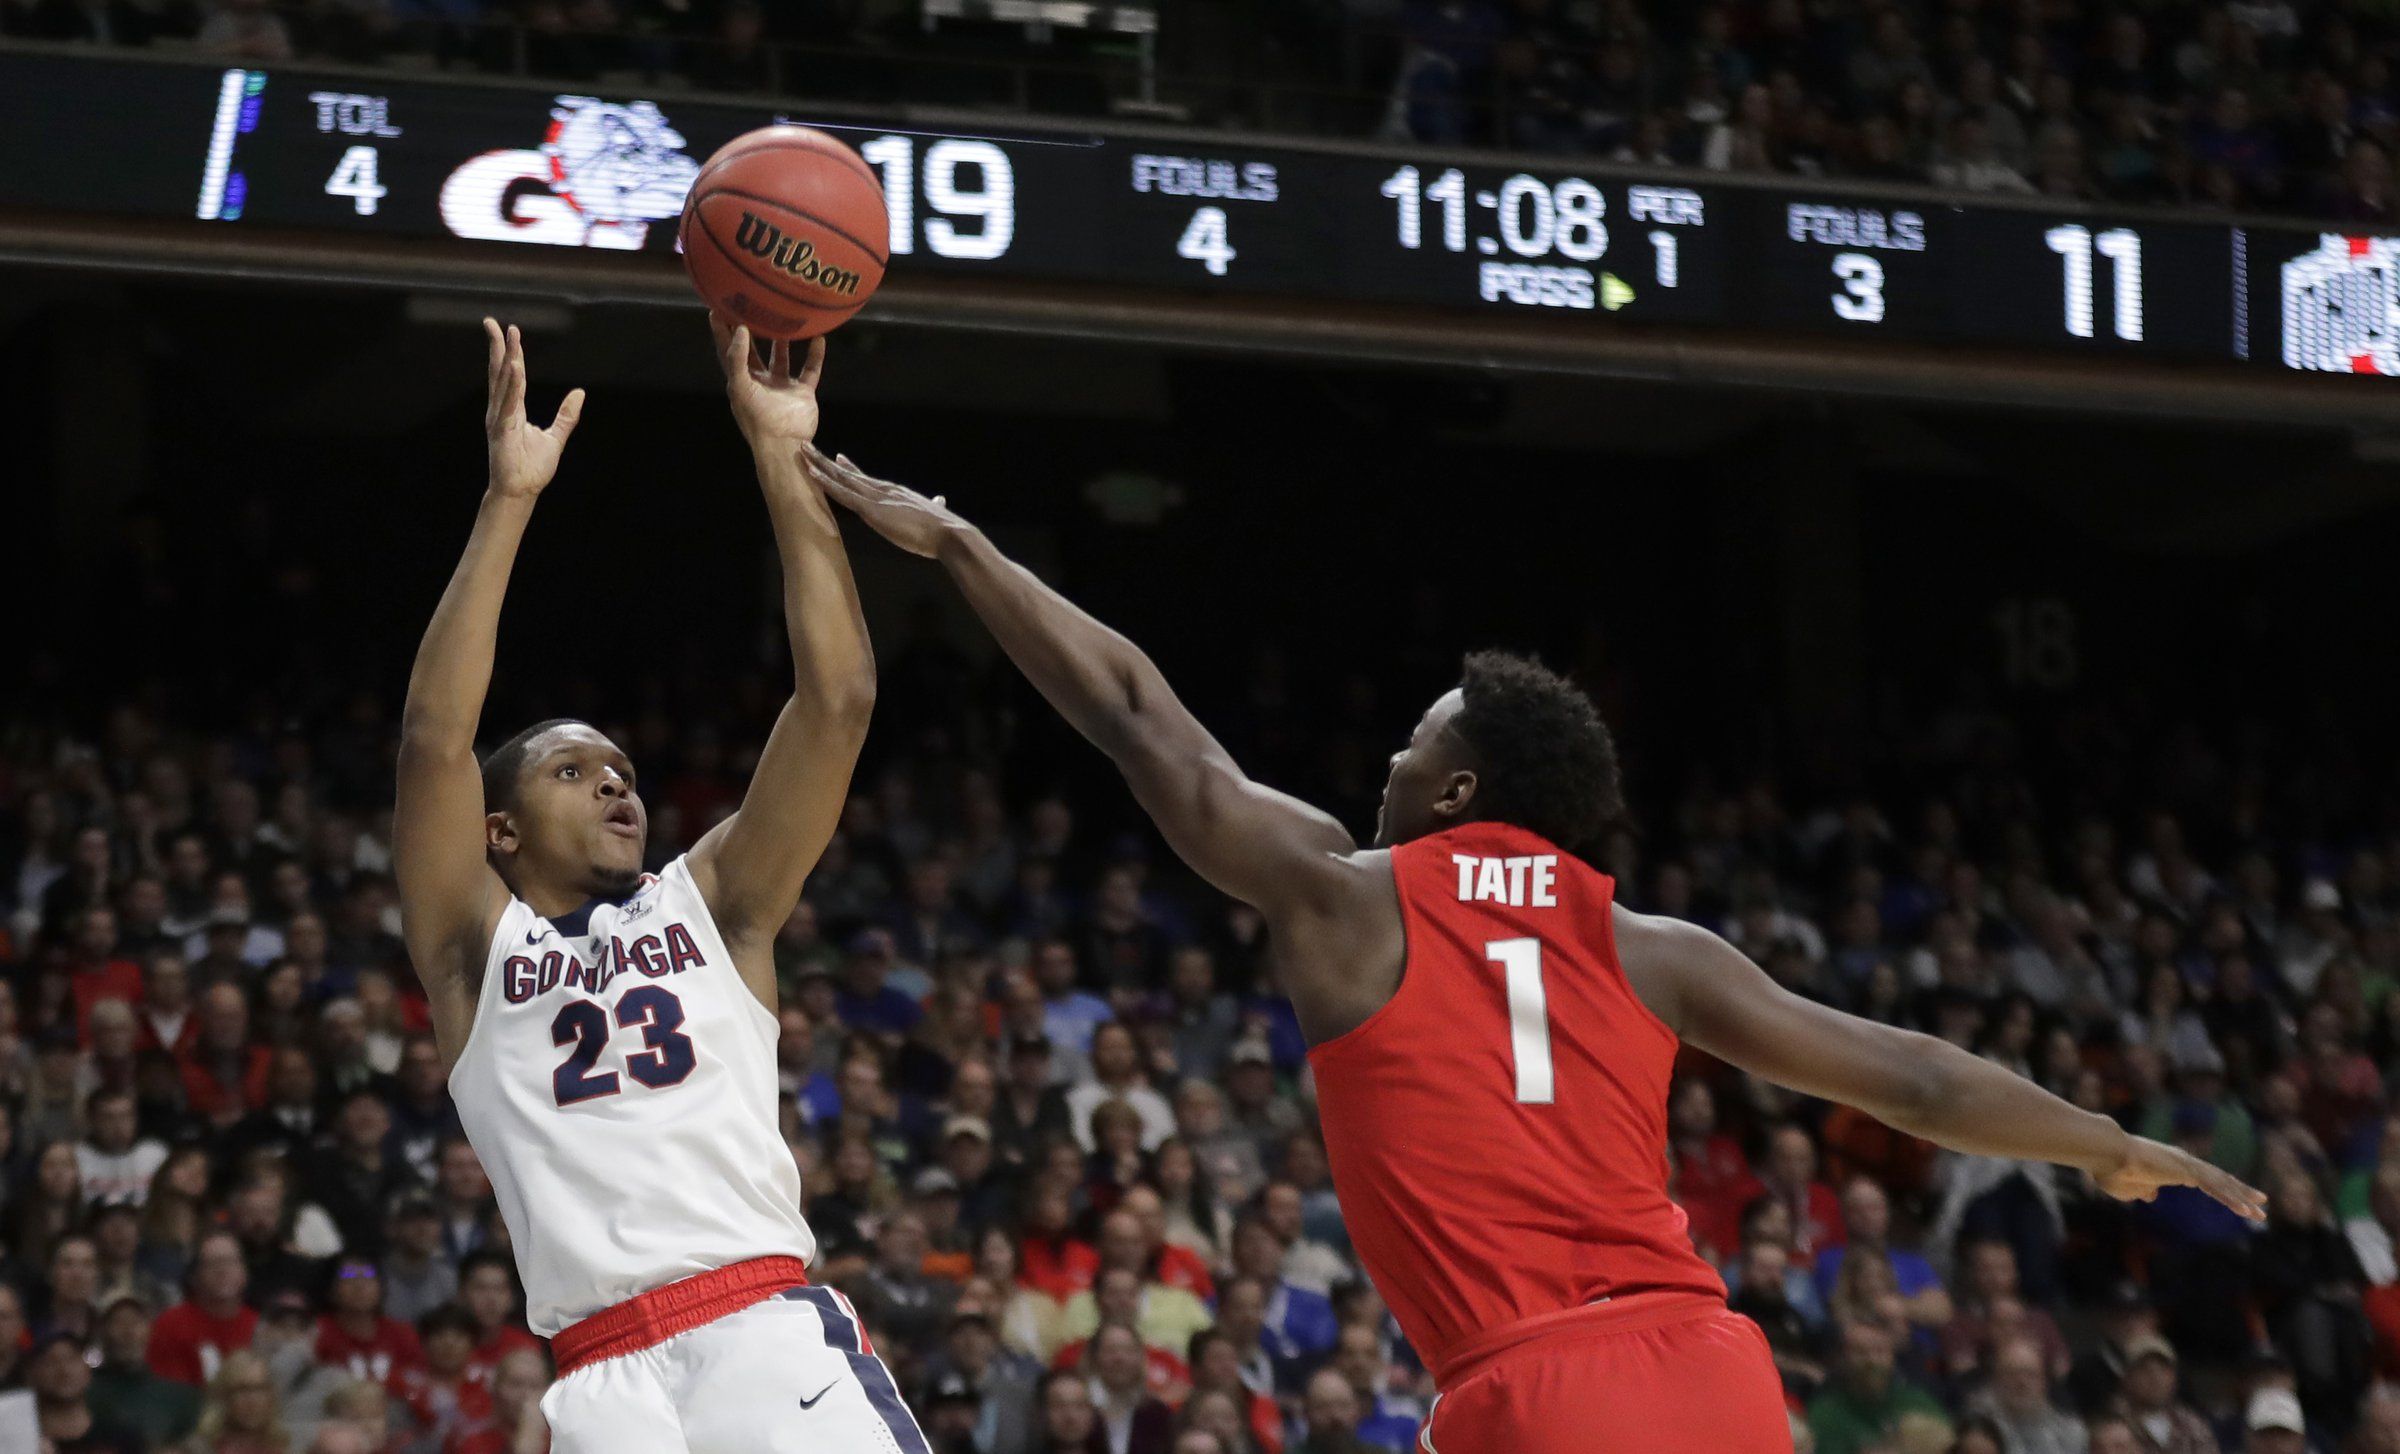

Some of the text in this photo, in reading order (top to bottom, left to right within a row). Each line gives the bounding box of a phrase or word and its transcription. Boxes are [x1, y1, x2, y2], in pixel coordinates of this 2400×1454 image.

[310, 91, 400, 136] TOL
[325, 145, 388, 216] 4
[863, 135, 1014, 260] 19
[1132, 154, 1279, 202] FOULS
[1380, 165, 1609, 261] 11:08
[1629, 185, 1705, 227] PER
[736, 211, 861, 297] Wilson
[1177, 206, 1237, 276] 4
[1648, 230, 1679, 288] 1
[1789, 204, 1927, 252] FOULS
[1480, 260, 1595, 310] POSS
[1832, 253, 1885, 323] 3
[2045, 223, 2144, 342] 11
[1452, 853, 1558, 908] TATE
[504, 923, 707, 1005] GONZAGA
[551, 984, 698, 1107] 23
[1485, 937, 1555, 1104] 1
